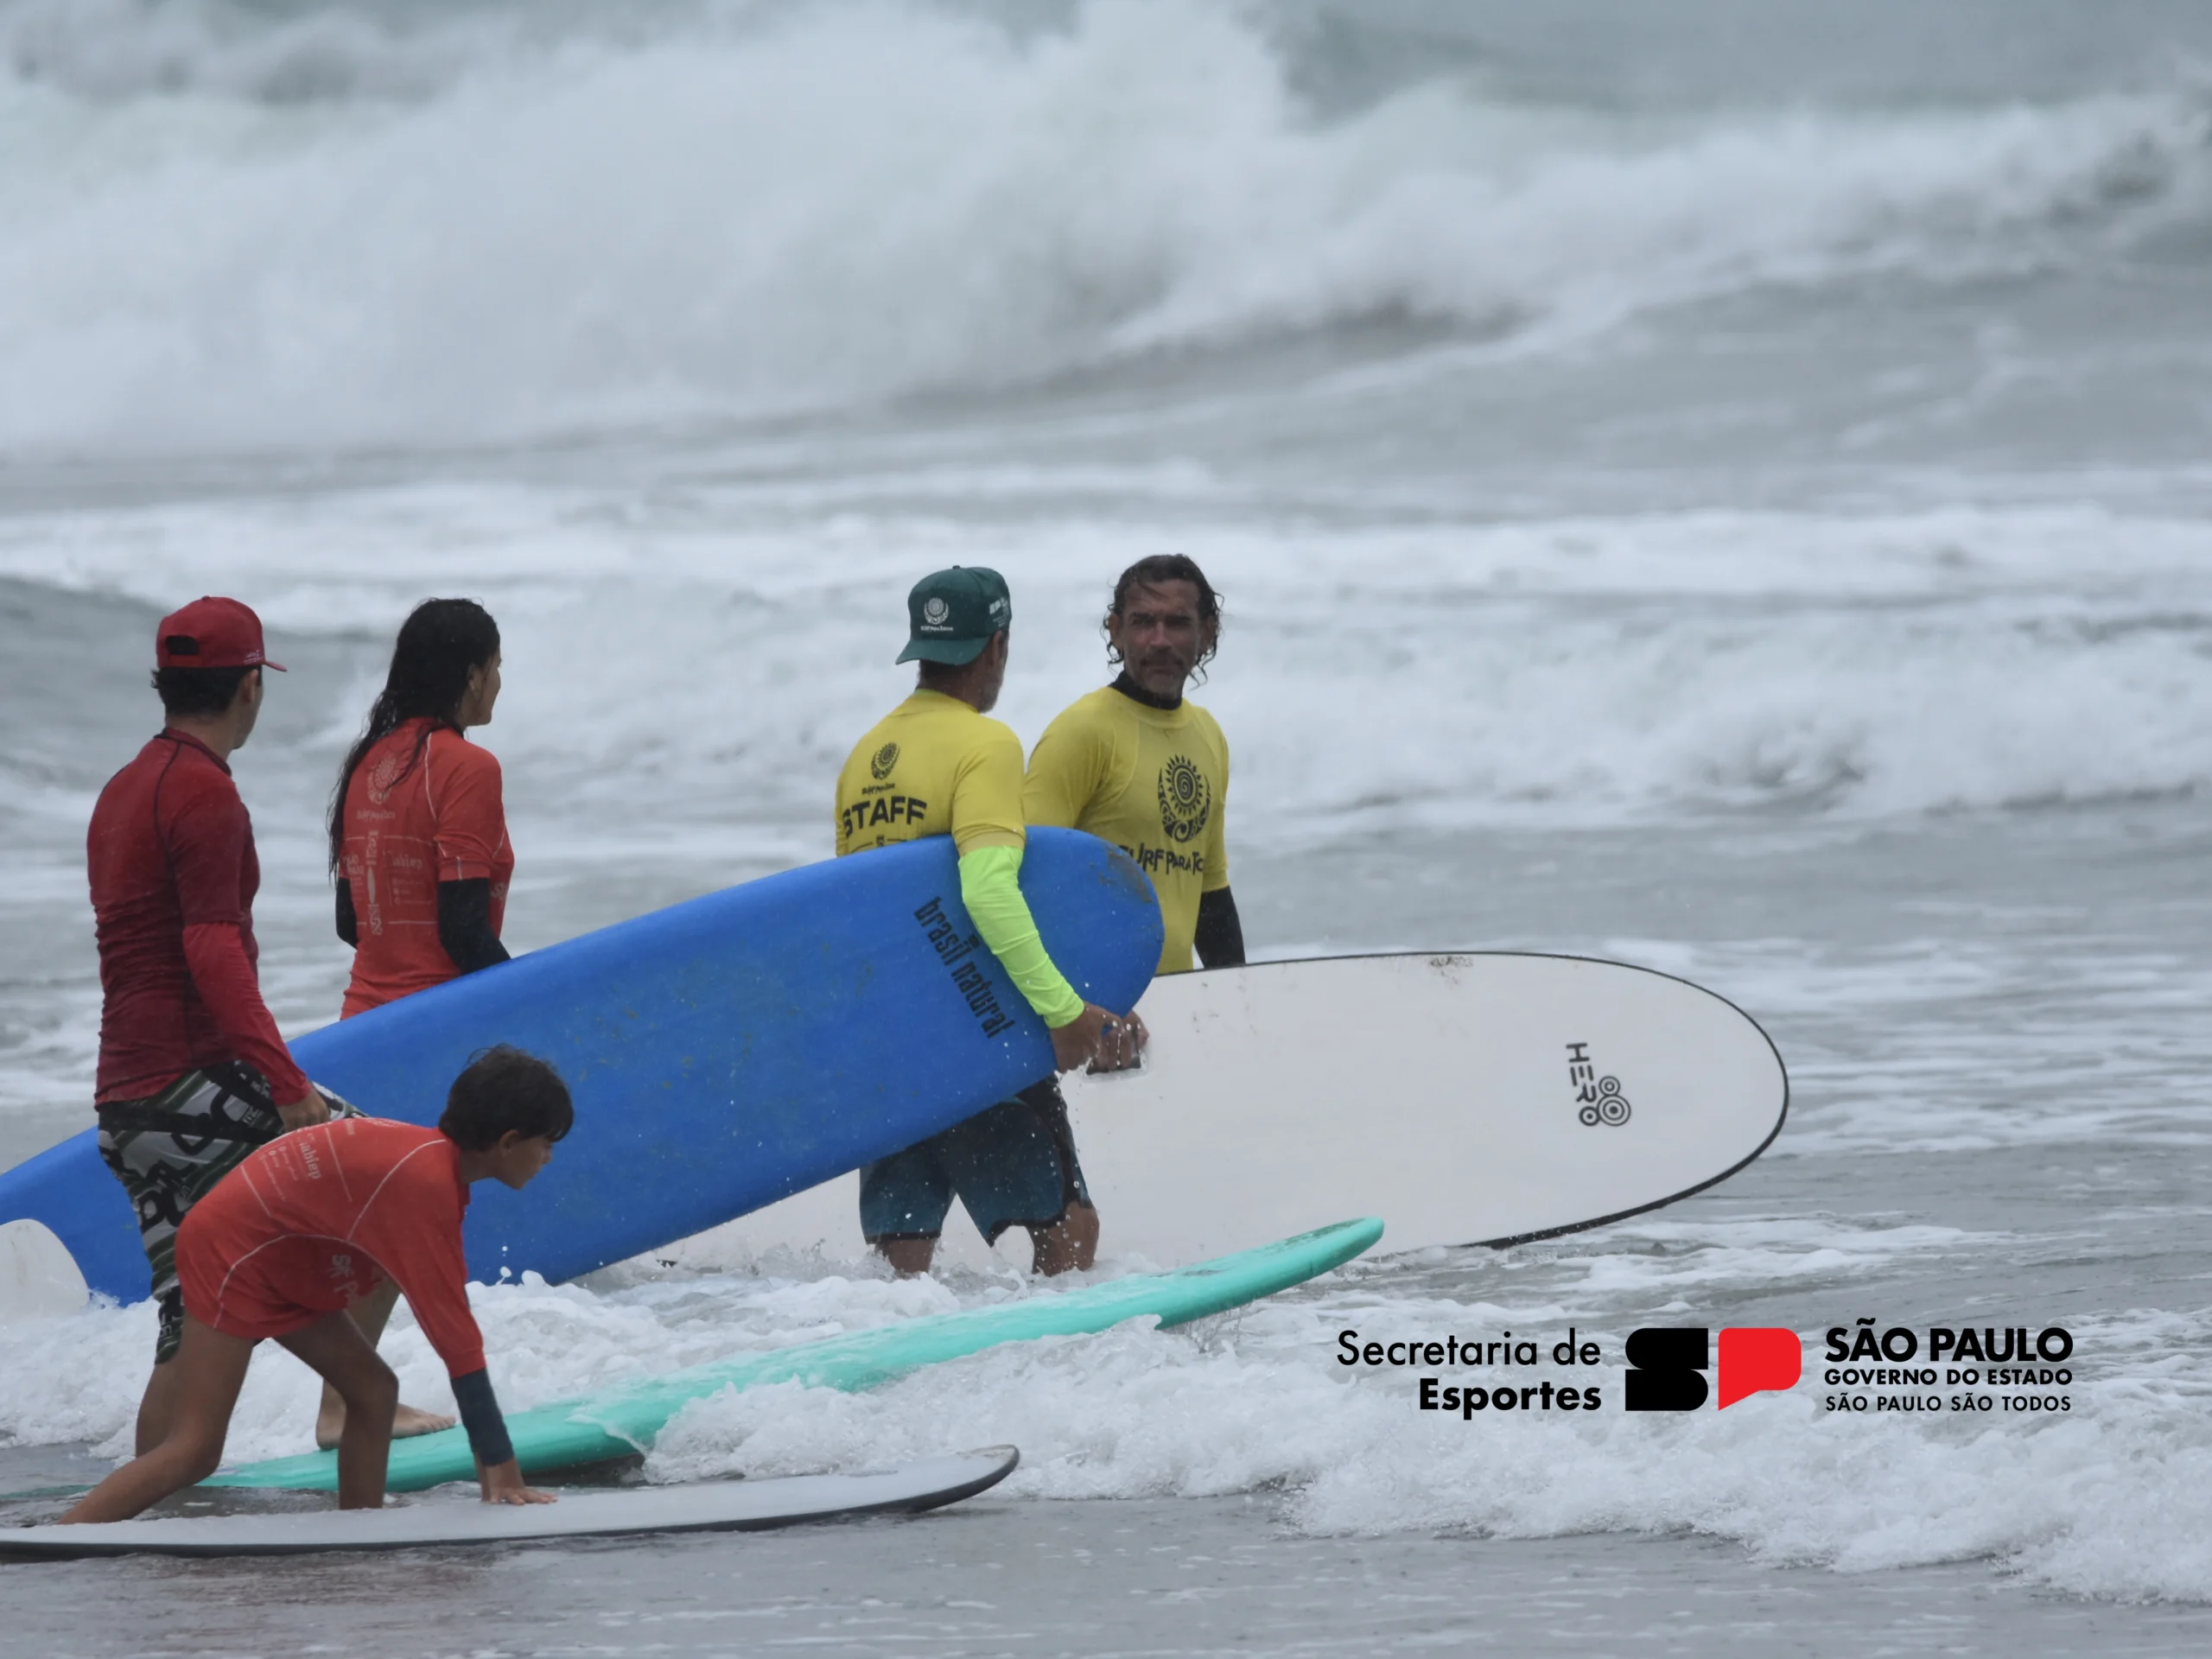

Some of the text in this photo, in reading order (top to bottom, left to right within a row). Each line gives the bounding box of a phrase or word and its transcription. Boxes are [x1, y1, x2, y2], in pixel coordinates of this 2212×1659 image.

[842, 795, 928, 839] STAFF
[913, 896, 1016, 1039] brasil natural
